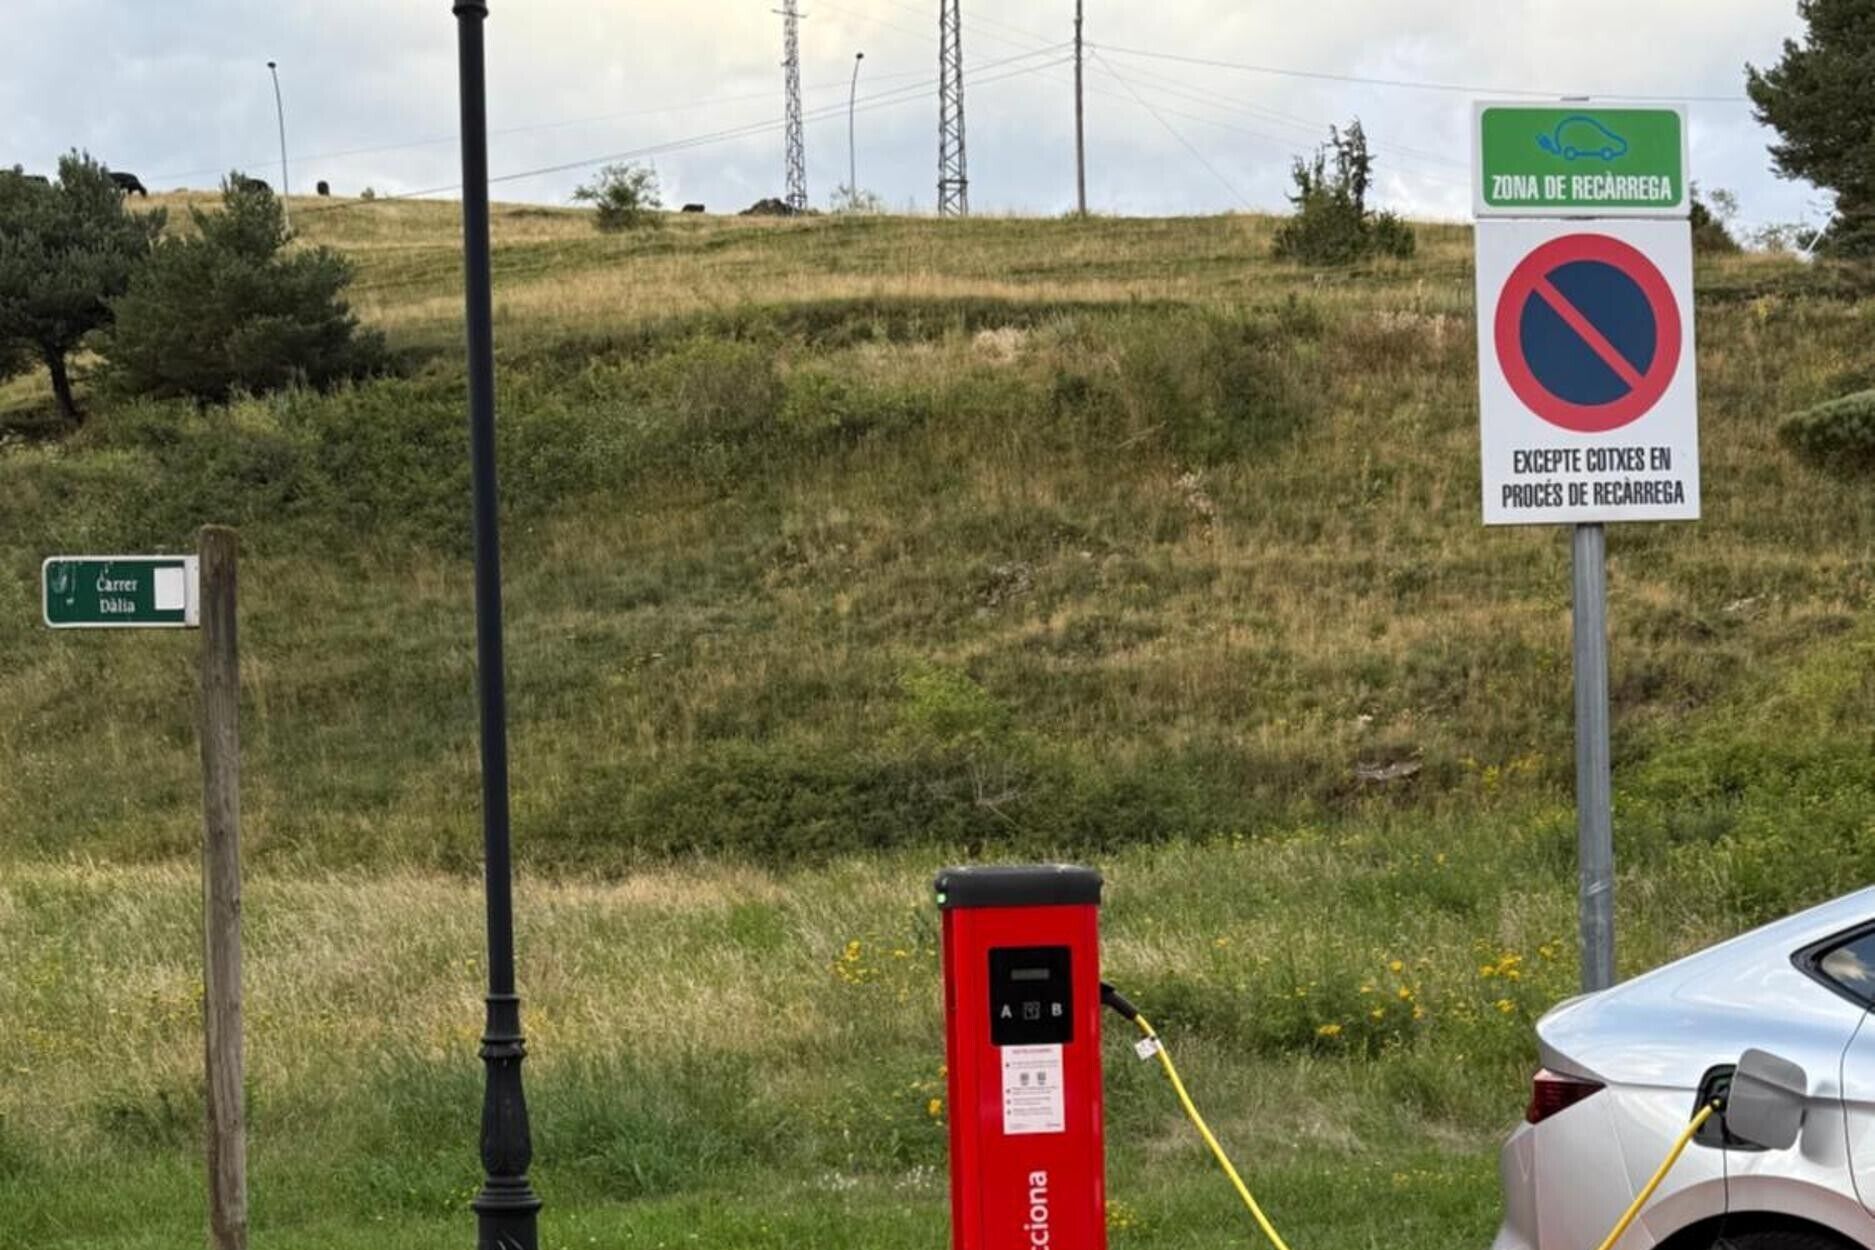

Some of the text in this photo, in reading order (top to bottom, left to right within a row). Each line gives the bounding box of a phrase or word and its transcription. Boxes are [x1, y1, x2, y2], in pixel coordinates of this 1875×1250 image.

[1491, 171, 1672, 200] ZONA DE RECÀRREGA
[1513, 447, 1671, 474] EXCEPTE COTXES EN
[1502, 476, 1685, 508] PROCÉS DE RECÀRREGA
[96, 578, 138, 592] Carrer
[1001, 1002, 1063, 1019] A B
